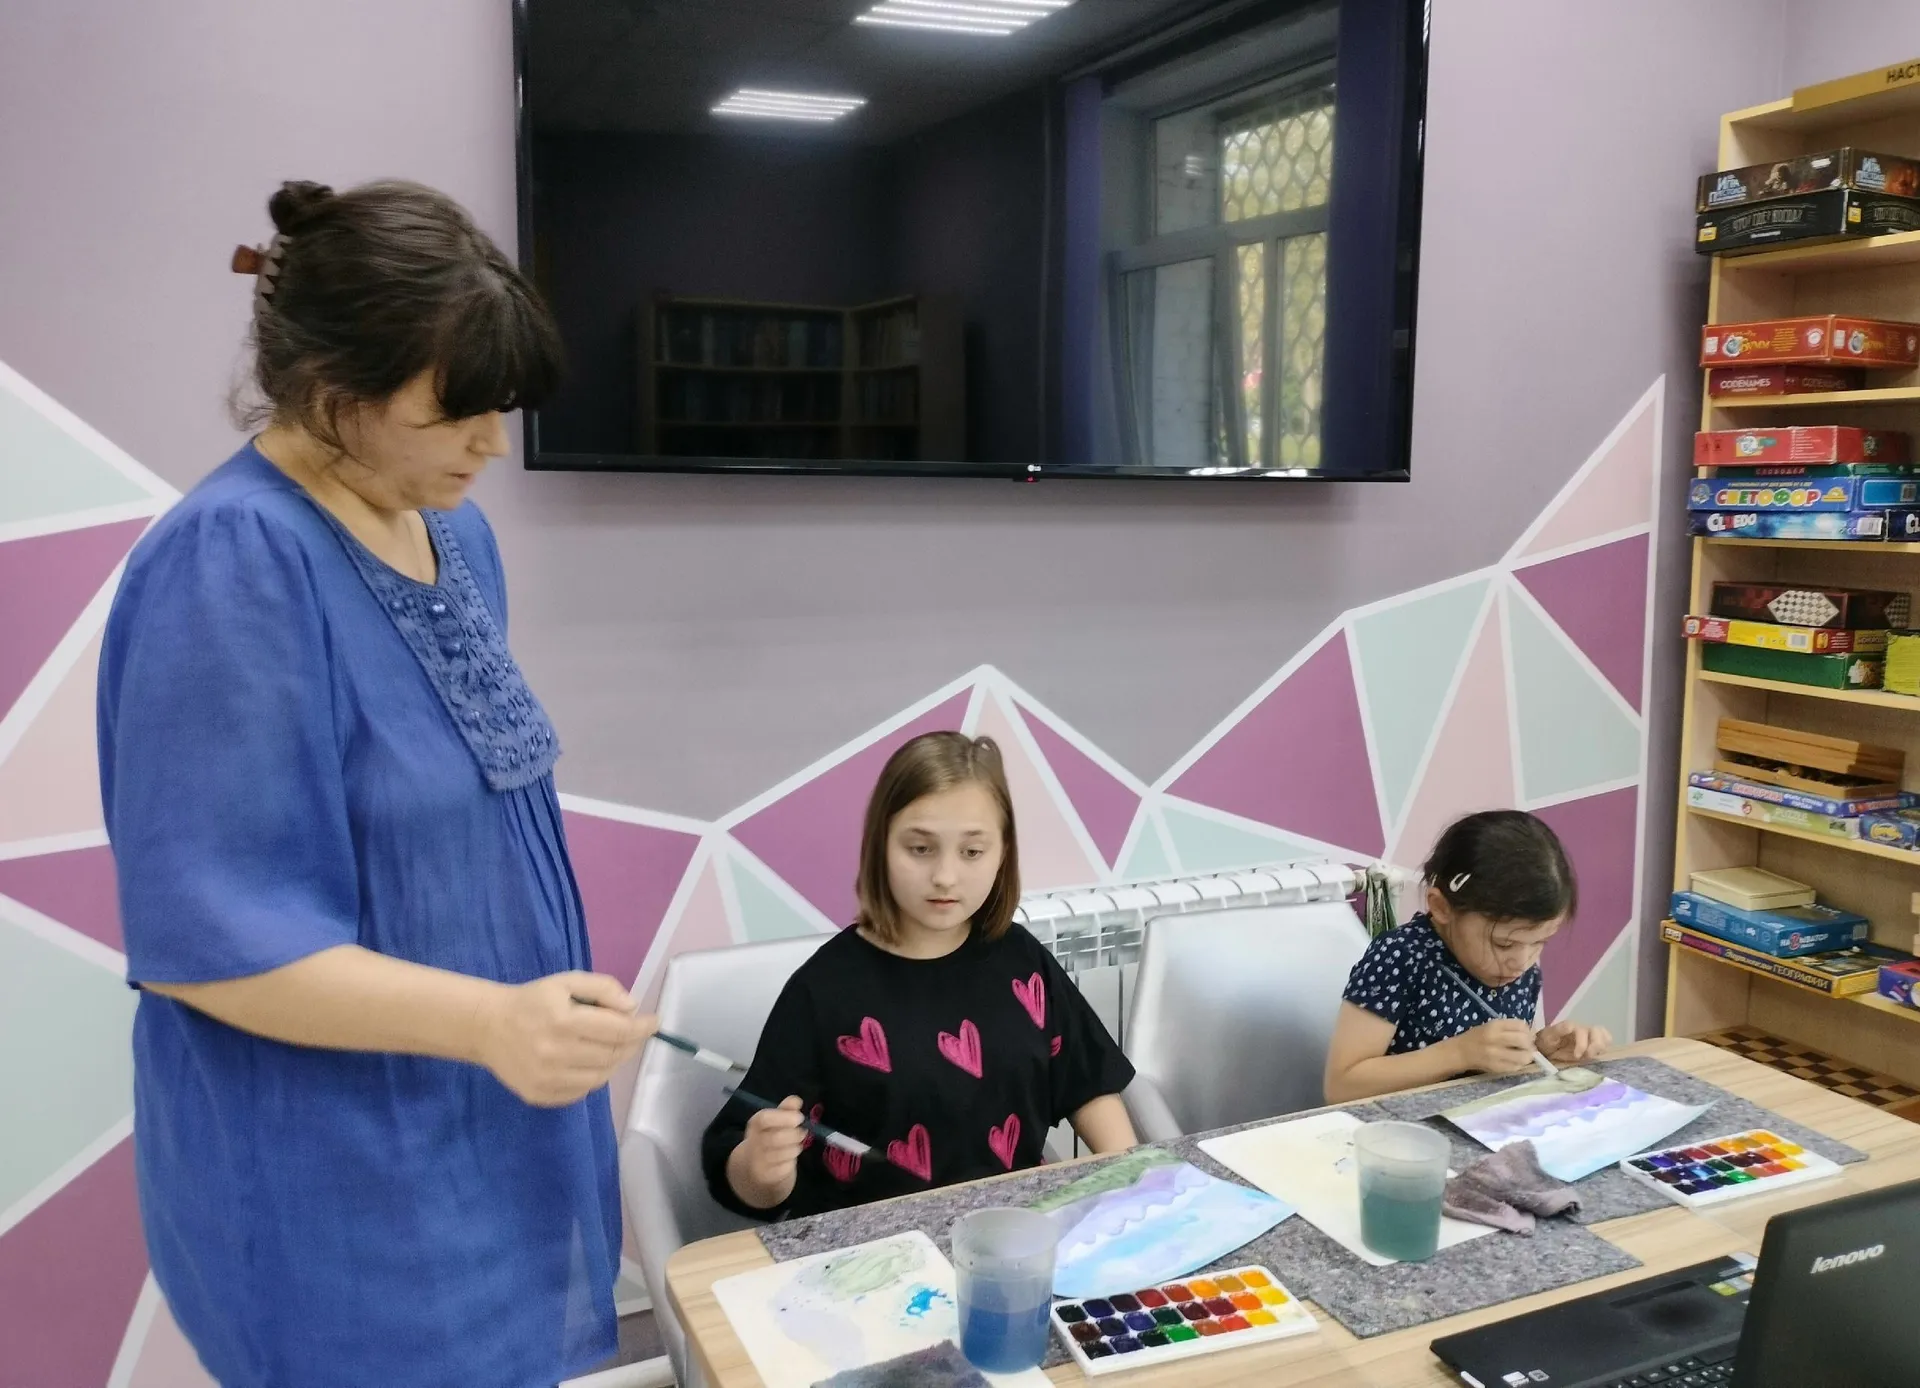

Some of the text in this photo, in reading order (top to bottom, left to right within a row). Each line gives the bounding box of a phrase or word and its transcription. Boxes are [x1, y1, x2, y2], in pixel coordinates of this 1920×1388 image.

[1720, 378, 1771, 389] CODENAMES
[1715, 488, 1821, 507] СВЕТОФОР
[1707, 513, 1757, 532] CLUEDO
[1773, 964, 1829, 989] ГЕОГРАФИИ
[1810, 1244, 1885, 1274] lenovo
